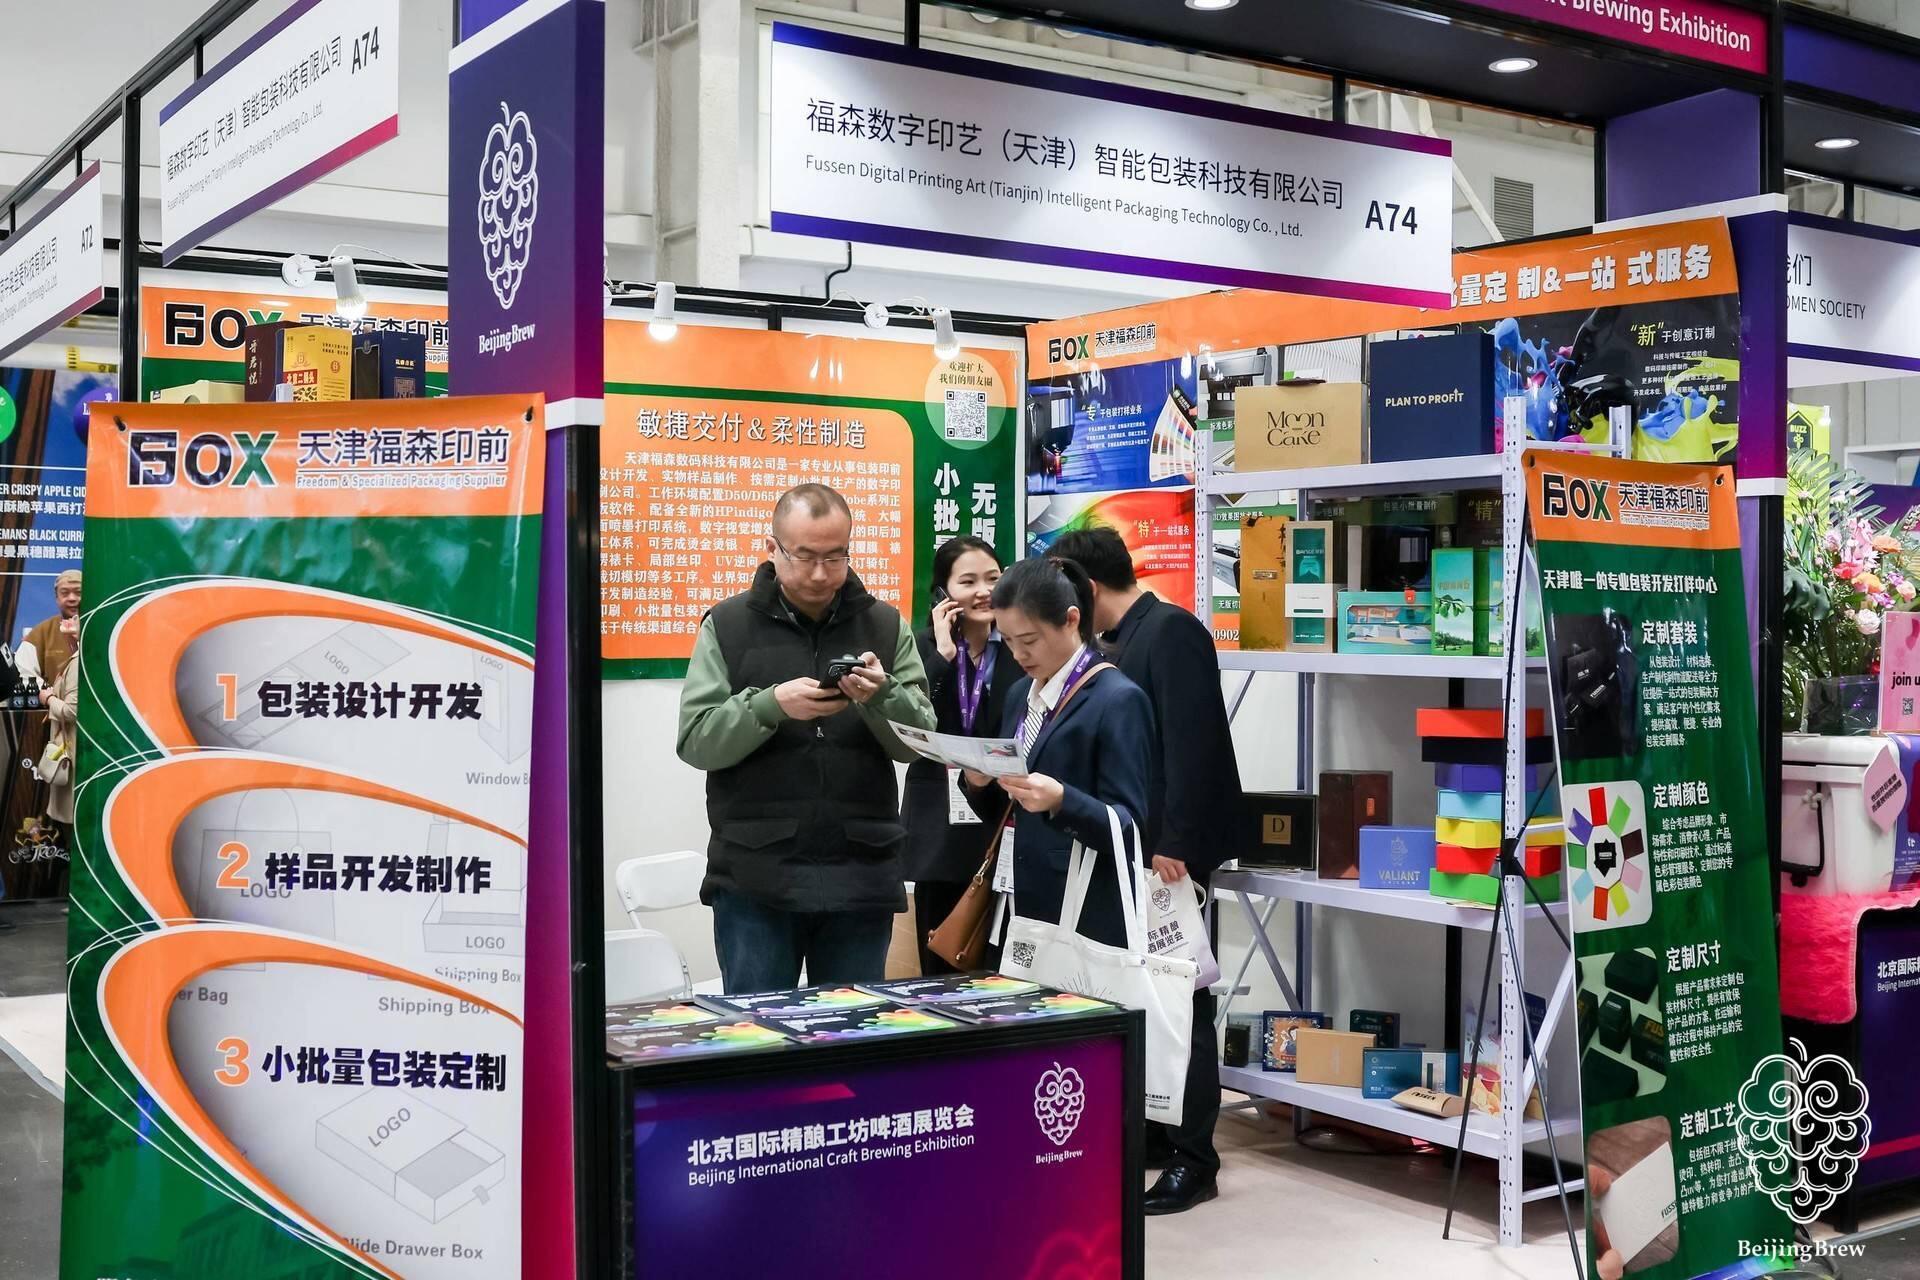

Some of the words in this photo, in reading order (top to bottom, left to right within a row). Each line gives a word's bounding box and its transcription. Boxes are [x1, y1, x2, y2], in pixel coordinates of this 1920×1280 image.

[1660, 8, 1750, 52] Exhibition
[352, 26, 380, 75] A74
[806, 155, 856, 176] Fussen
[860, 162, 905, 184] Digital
[908, 169, 963, 195] Printing
[966, 177, 986, 194] Art
[989, 180, 1043, 205] (Tianjin)
[1047, 189, 1112, 213] Intelligent
[1115, 199, 1178, 225] Packaging
[1181, 209, 1250, 234] Technology
[1281, 222, 1303, 238] Ltd.
[1365, 200, 1418, 235] A74
[81, 225, 94, 254] A72
[1820, 299, 1866, 320] SOCIETY
[479, 322, 536, 356] BeijingBrew
[1095, 323, 1157, 348] 天津福森印前
[949, 360, 984, 374] 欢迎扩大
[939, 373, 993, 387] 我们的朋友圈
[1385, 397, 1411, 408] PLAN
[1413, 395, 1427, 405] TO
[1428, 389, 1464, 404] PROFIT
[1209, 420, 1235, 431] 标准色彩
[1267, 411, 1324, 429] Moon
[1790, 424, 1808, 434] BUZZ
[297, 428, 510, 467] 天津福森印前
[1267, 428, 1321, 447] Cake
[11, 484, 42, 496] CRISPY
[44, 485, 71, 497] APPLE
[297, 476, 338, 488] Freedom
[341, 476, 349, 487] &
[352, 475, 408, 488] Specialized
[411, 474, 461, 489] Packaging
[464, 473, 506, 487] Supplier
[0, 499, 85, 515] 酥脆苹果西打
[1619, 481, 1709, 514] 天津福森印前
[29, 529, 57, 541] BLACK
[1543, 569, 1718, 594] 天津唯一的专业包装开发打样中心
[1641, 620, 1698, 646] 定制套装
[324, 650, 350, 676] LOGO
[480, 655, 504, 671] LOGO
[1891, 671, 1911, 690] join
[216, 673, 238, 721] 1
[257, 681, 483, 720] 包装设计开发
[466, 772, 520, 786] Window
[1652, 780, 1710, 808] 定制颜色
[1271, 818, 1285, 833] D
[216, 841, 250, 889] 2
[264, 852, 491, 894] 样品开发制作
[1378, 870, 1421, 881] VALIANT
[240, 882, 292, 899] LOGO
[465, 936, 505, 950] LOGO
[1666, 940, 1721, 973] 定制尺寸
[502, 969, 521, 983] Box
[198, 987, 228, 1005] Bag
[378, 997, 453, 1016] Shipping
[460, 1000, 490, 1014] Box
[213, 1037, 251, 1087] 3
[261, 1045, 506, 1092] 小批量包装定制
[366, 1106, 412, 1148] LOGO
[1680, 1102, 1736, 1140] 定制工艺
[687, 1103, 975, 1166] 北京国际精酿工坊啤酒展览会
[688, 1167, 736, 1188] Beijing
[738, 1153, 824, 1180] International
[827, 1147, 858, 1167] Craft
[861, 1141, 912, 1162] Brewing
[915, 1132, 975, 1154] Exhibition
[1035, 1149, 1083, 1165] BeijingBrew
[1689, 1134, 1753, 1163] 包括但不限于丝印、
[385, 1240, 446, 1257] Drawer
[452, 1243, 483, 1260] Box
